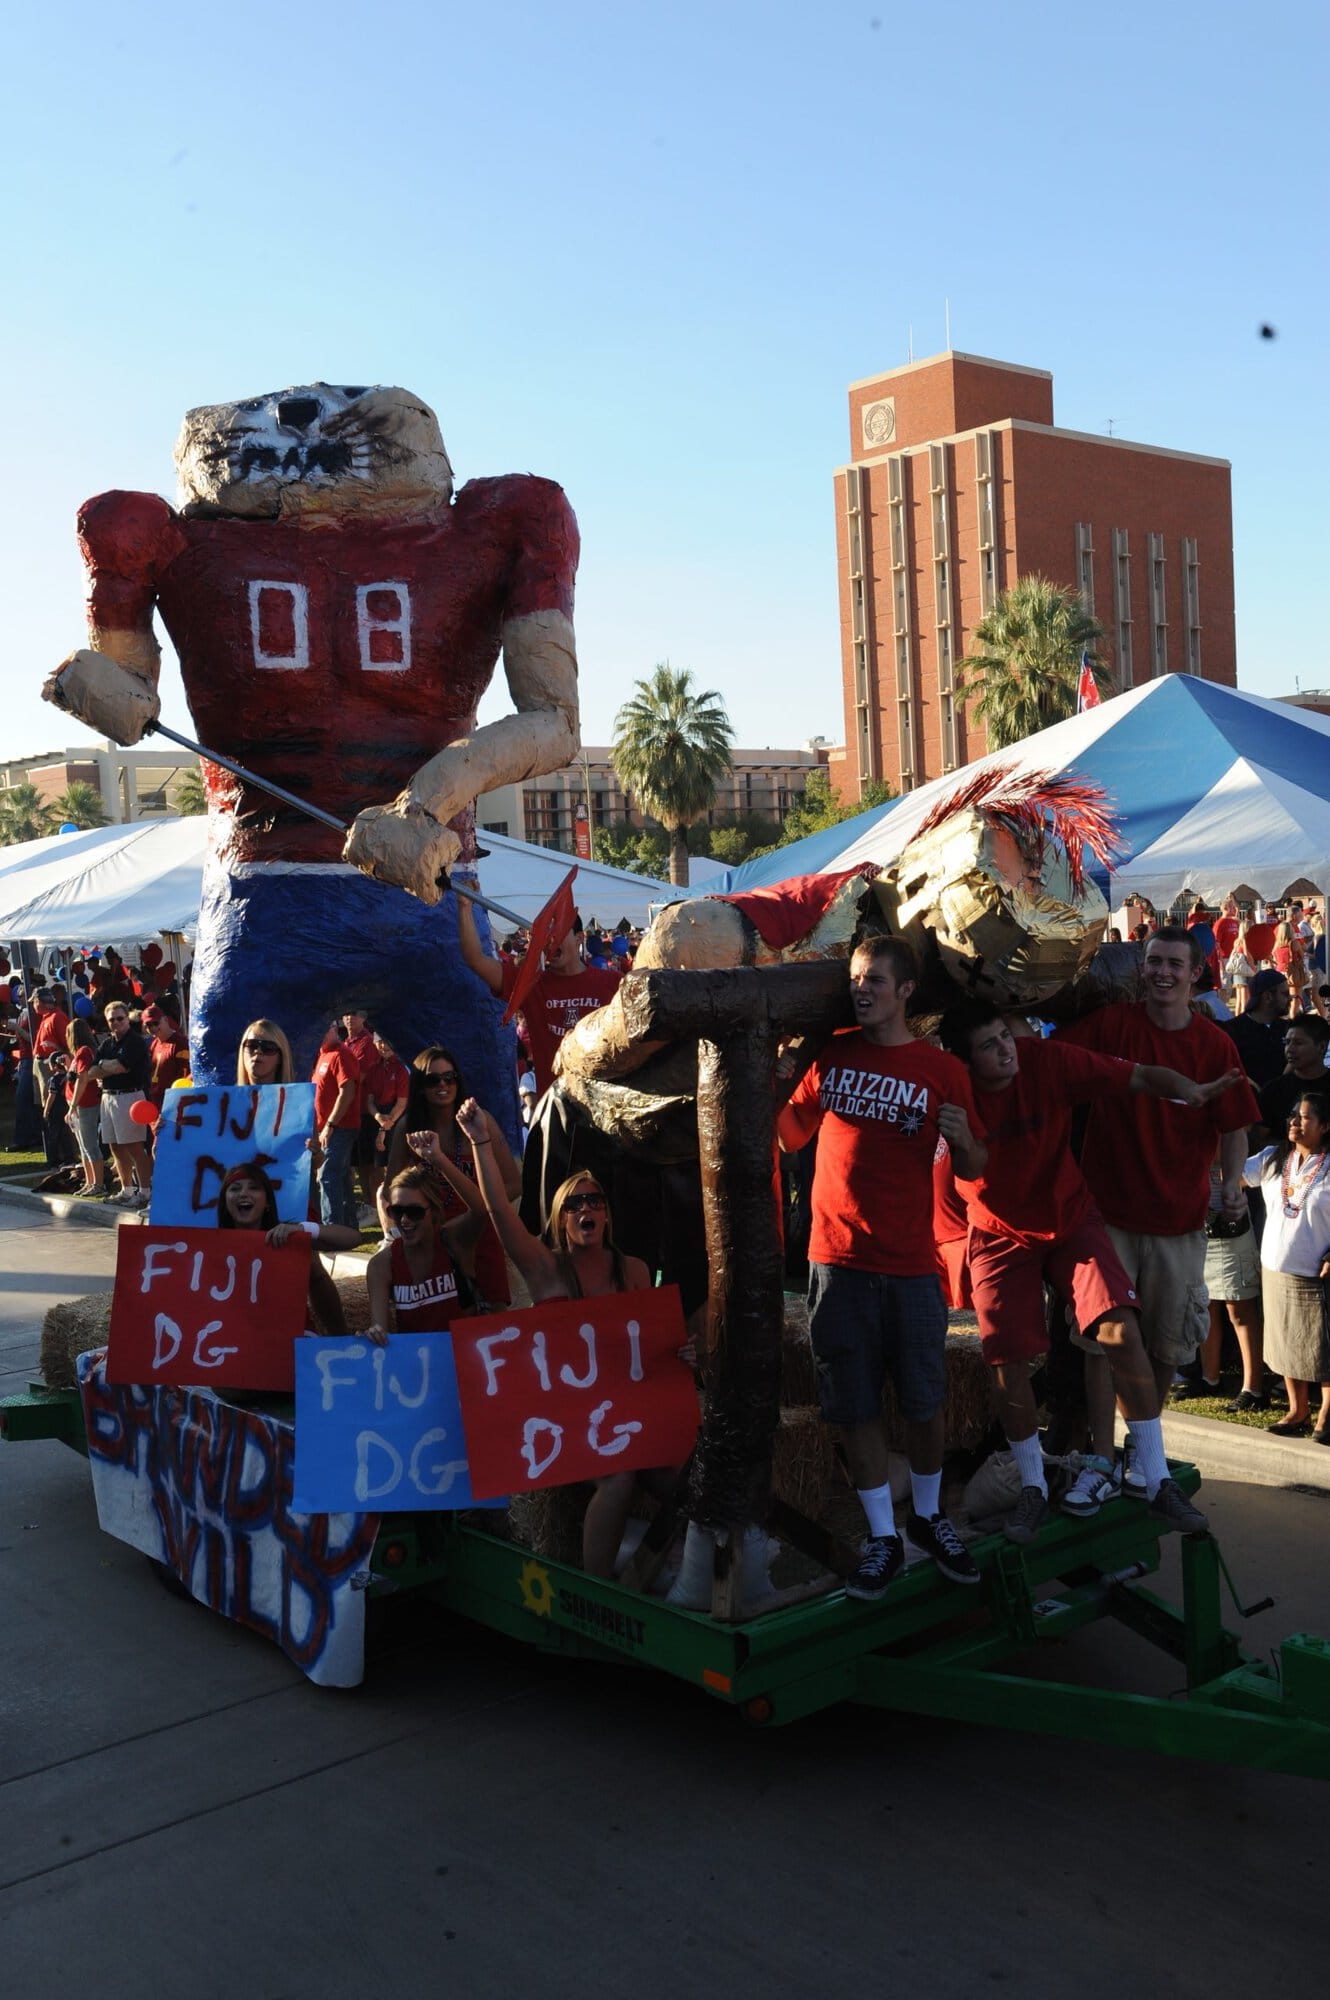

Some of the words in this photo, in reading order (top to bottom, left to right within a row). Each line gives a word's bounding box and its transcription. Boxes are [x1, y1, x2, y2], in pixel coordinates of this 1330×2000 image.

[546, 997, 600, 1009] OFFICIAL
[175, 1087, 286, 1141] FIJI
[819, 1091, 899, 1123] WILDCATS
[820, 1066, 929, 1114] ARIZONA
[141, 1241, 262, 1303] FIJI
[152, 1312, 238, 1369] DG
[476, 1320, 644, 1395] FIJI
[316, 1344, 430, 1411] FIJ
[354, 1428, 468, 1502] DG
[521, 1400, 643, 1480] DG
